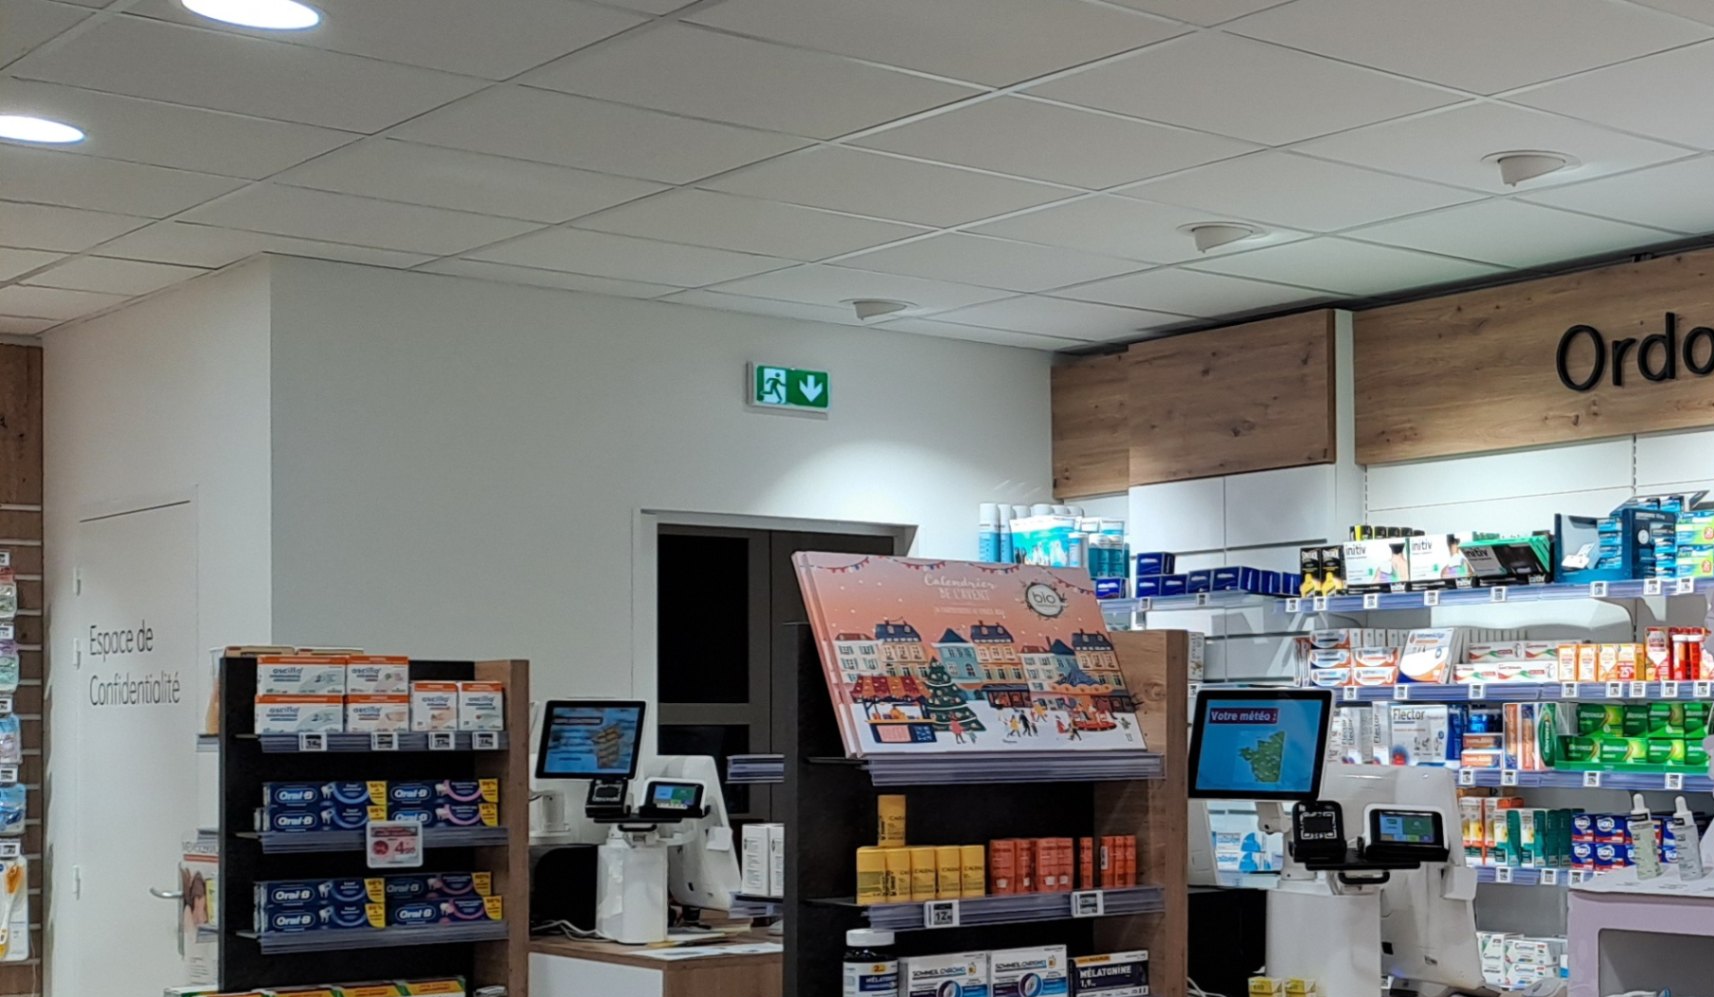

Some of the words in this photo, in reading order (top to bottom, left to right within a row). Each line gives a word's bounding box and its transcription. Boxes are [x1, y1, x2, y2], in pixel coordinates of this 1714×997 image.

[89, 622, 133, 661] Espace
[136, 620, 154, 653] de
[89, 670, 181, 707] Confidentialité
[1211, 711, 1237, 721] Votre
[1240, 710, 1270, 721] météo
[1392, 708, 1425, 721] Flector
[1080, 965, 1132, 979] MÉLATONINE
